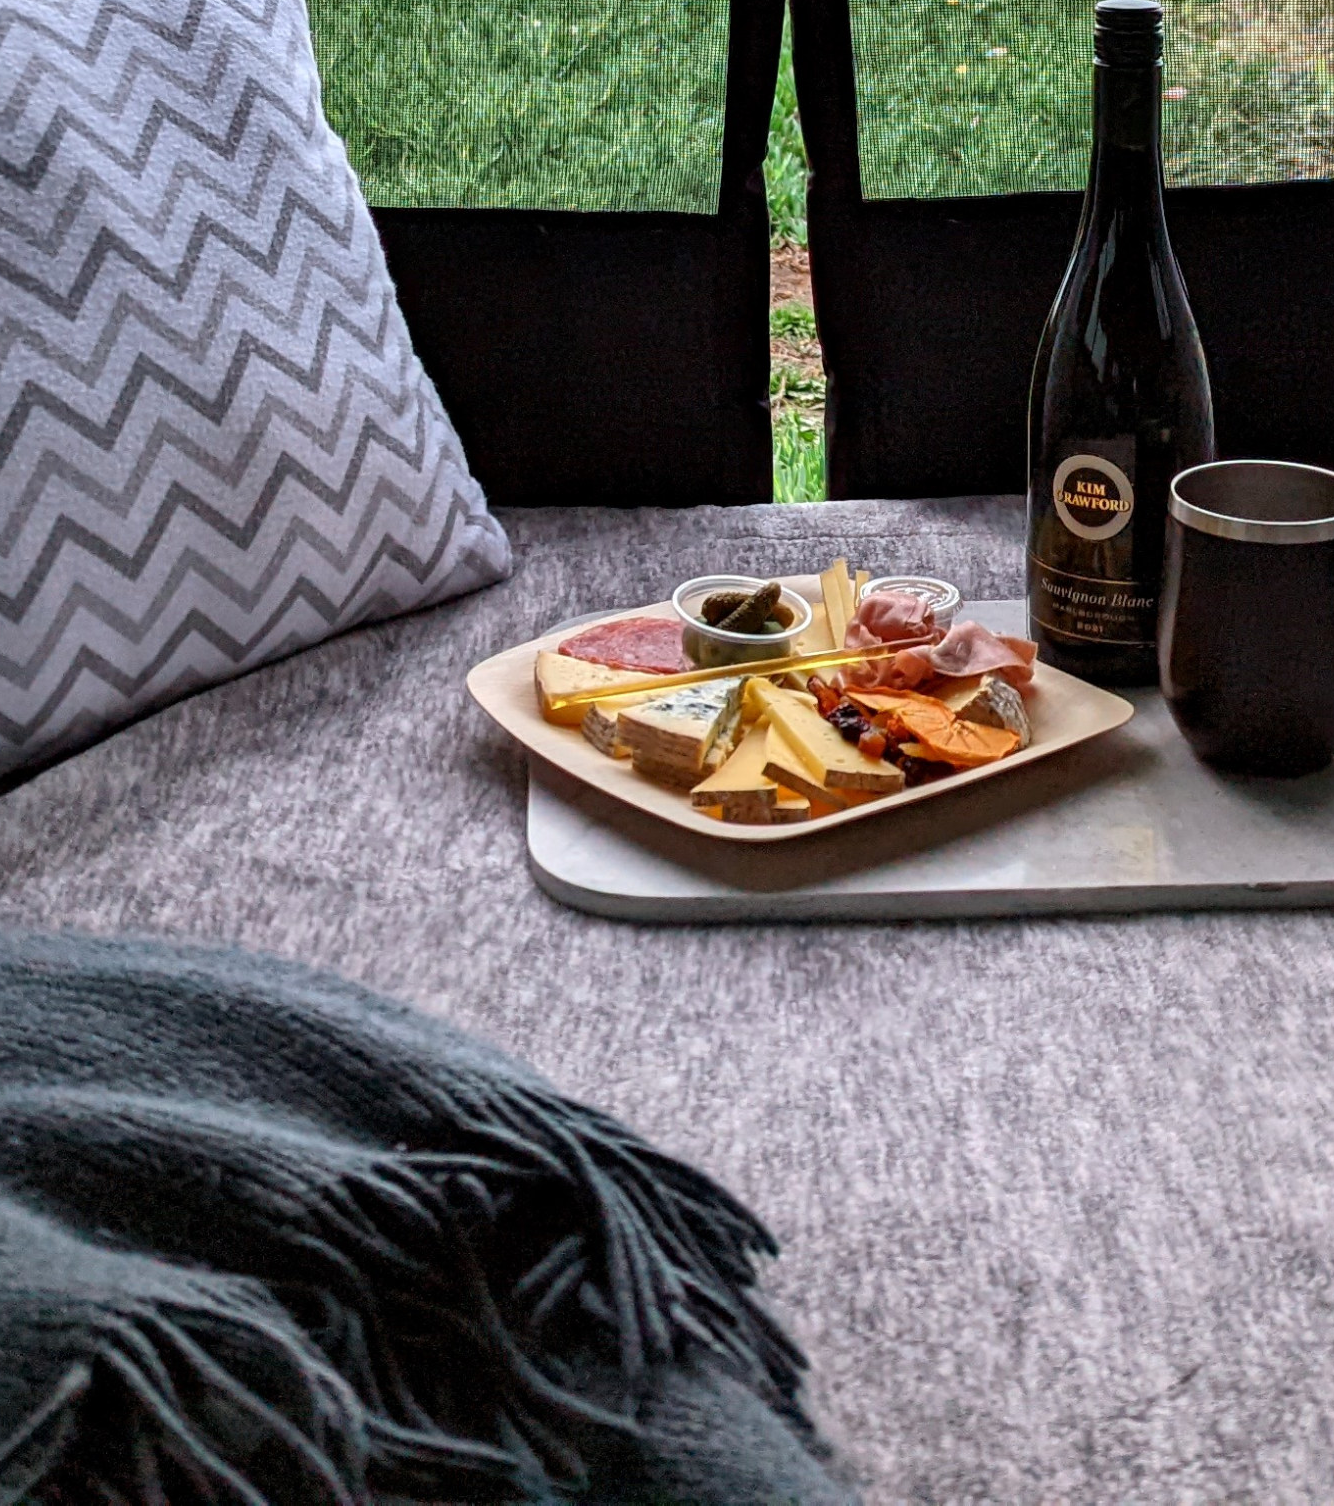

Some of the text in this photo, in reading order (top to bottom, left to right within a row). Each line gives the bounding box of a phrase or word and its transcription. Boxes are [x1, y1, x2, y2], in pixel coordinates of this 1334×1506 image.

[1076, 480, 1106, 497] KIM
[1057, 489, 1131, 513] CRAWFORD
[1040, 576, 1154, 609] Sauvignon Blanc
